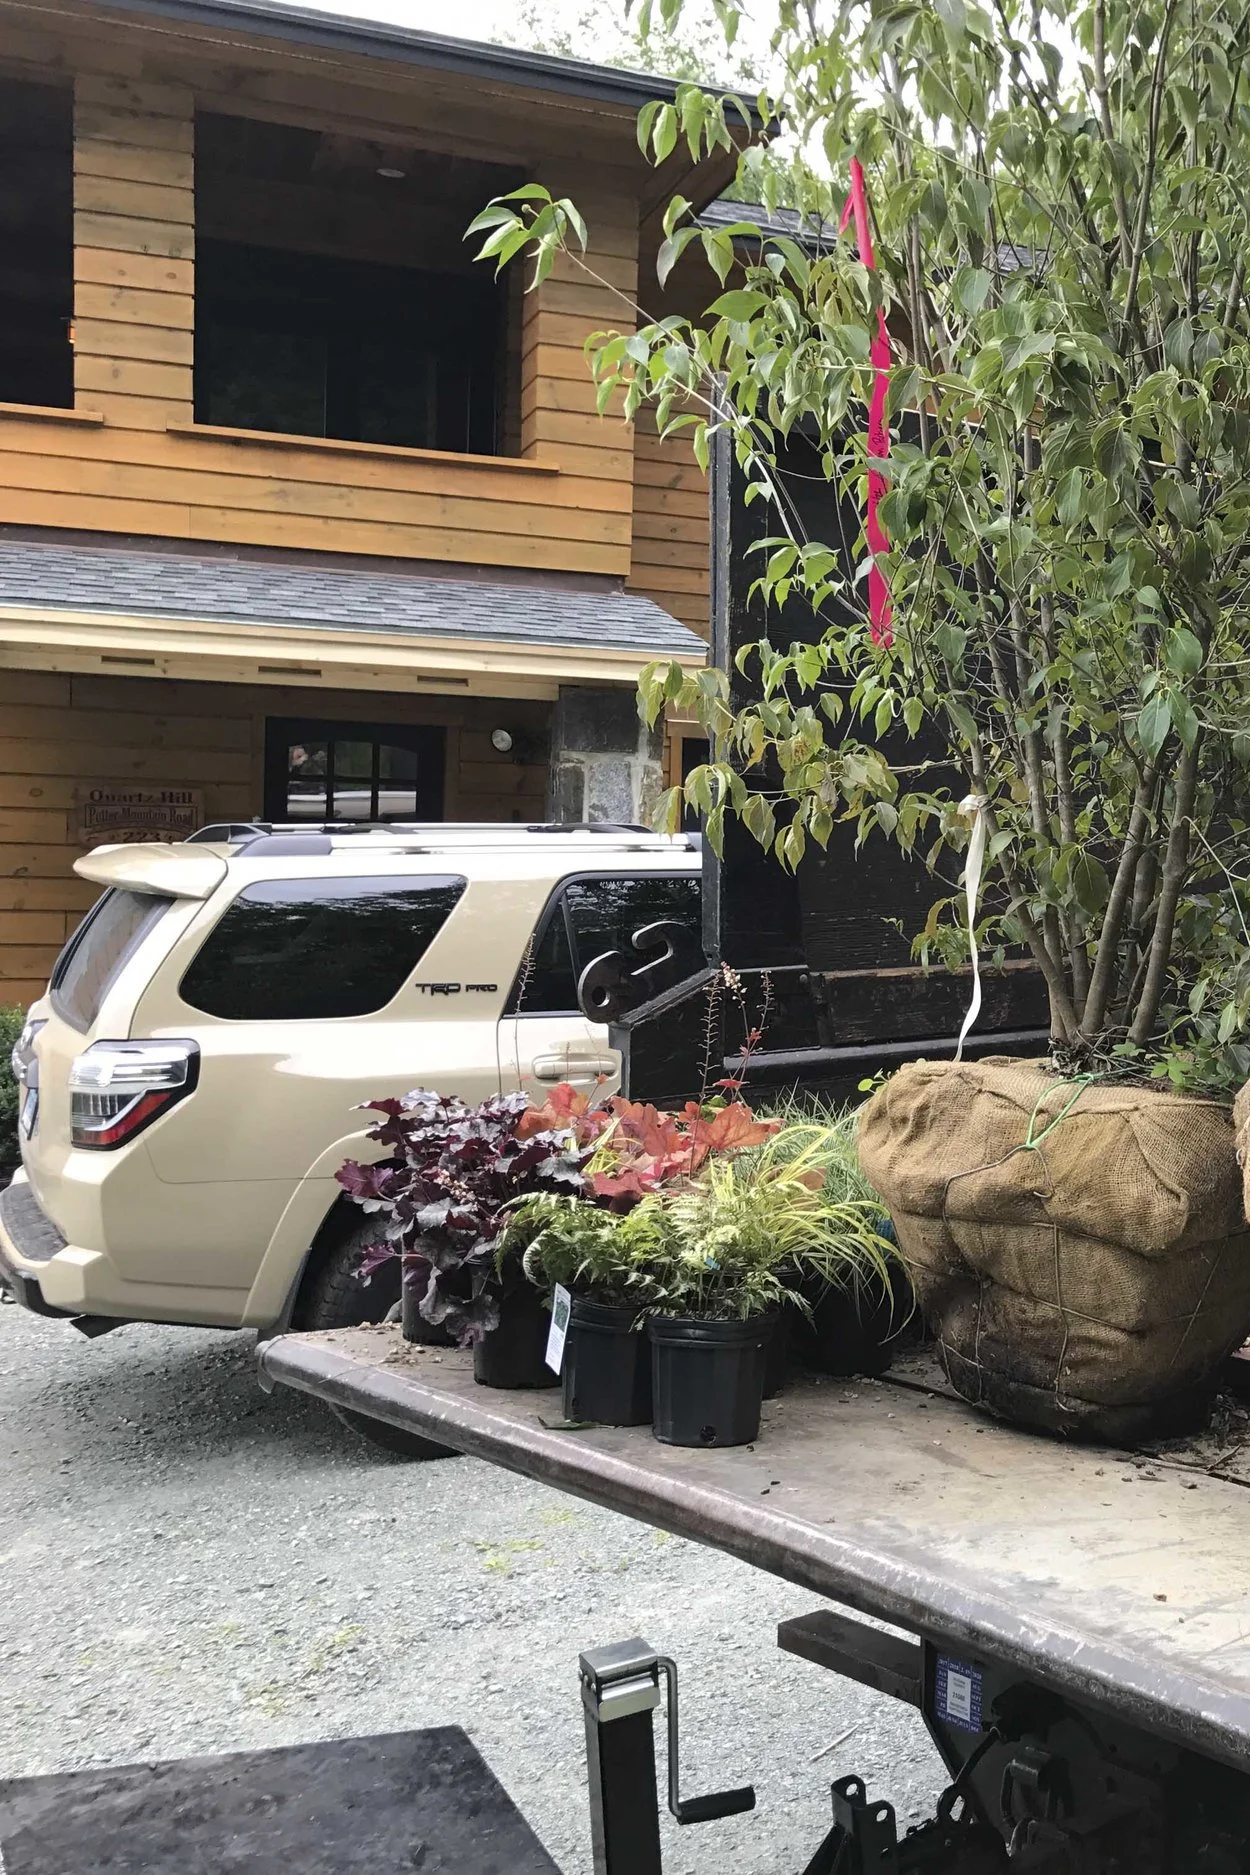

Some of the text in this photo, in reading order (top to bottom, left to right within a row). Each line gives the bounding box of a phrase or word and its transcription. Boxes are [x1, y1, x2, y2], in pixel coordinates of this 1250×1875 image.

[89, 789, 194, 804] Quartz Hill
[121, 806, 168, 822] Mountain
[169, 807, 194, 826] Road
[123, 831, 161, 843] 223
[415, 983, 498, 996] TRD PRO
